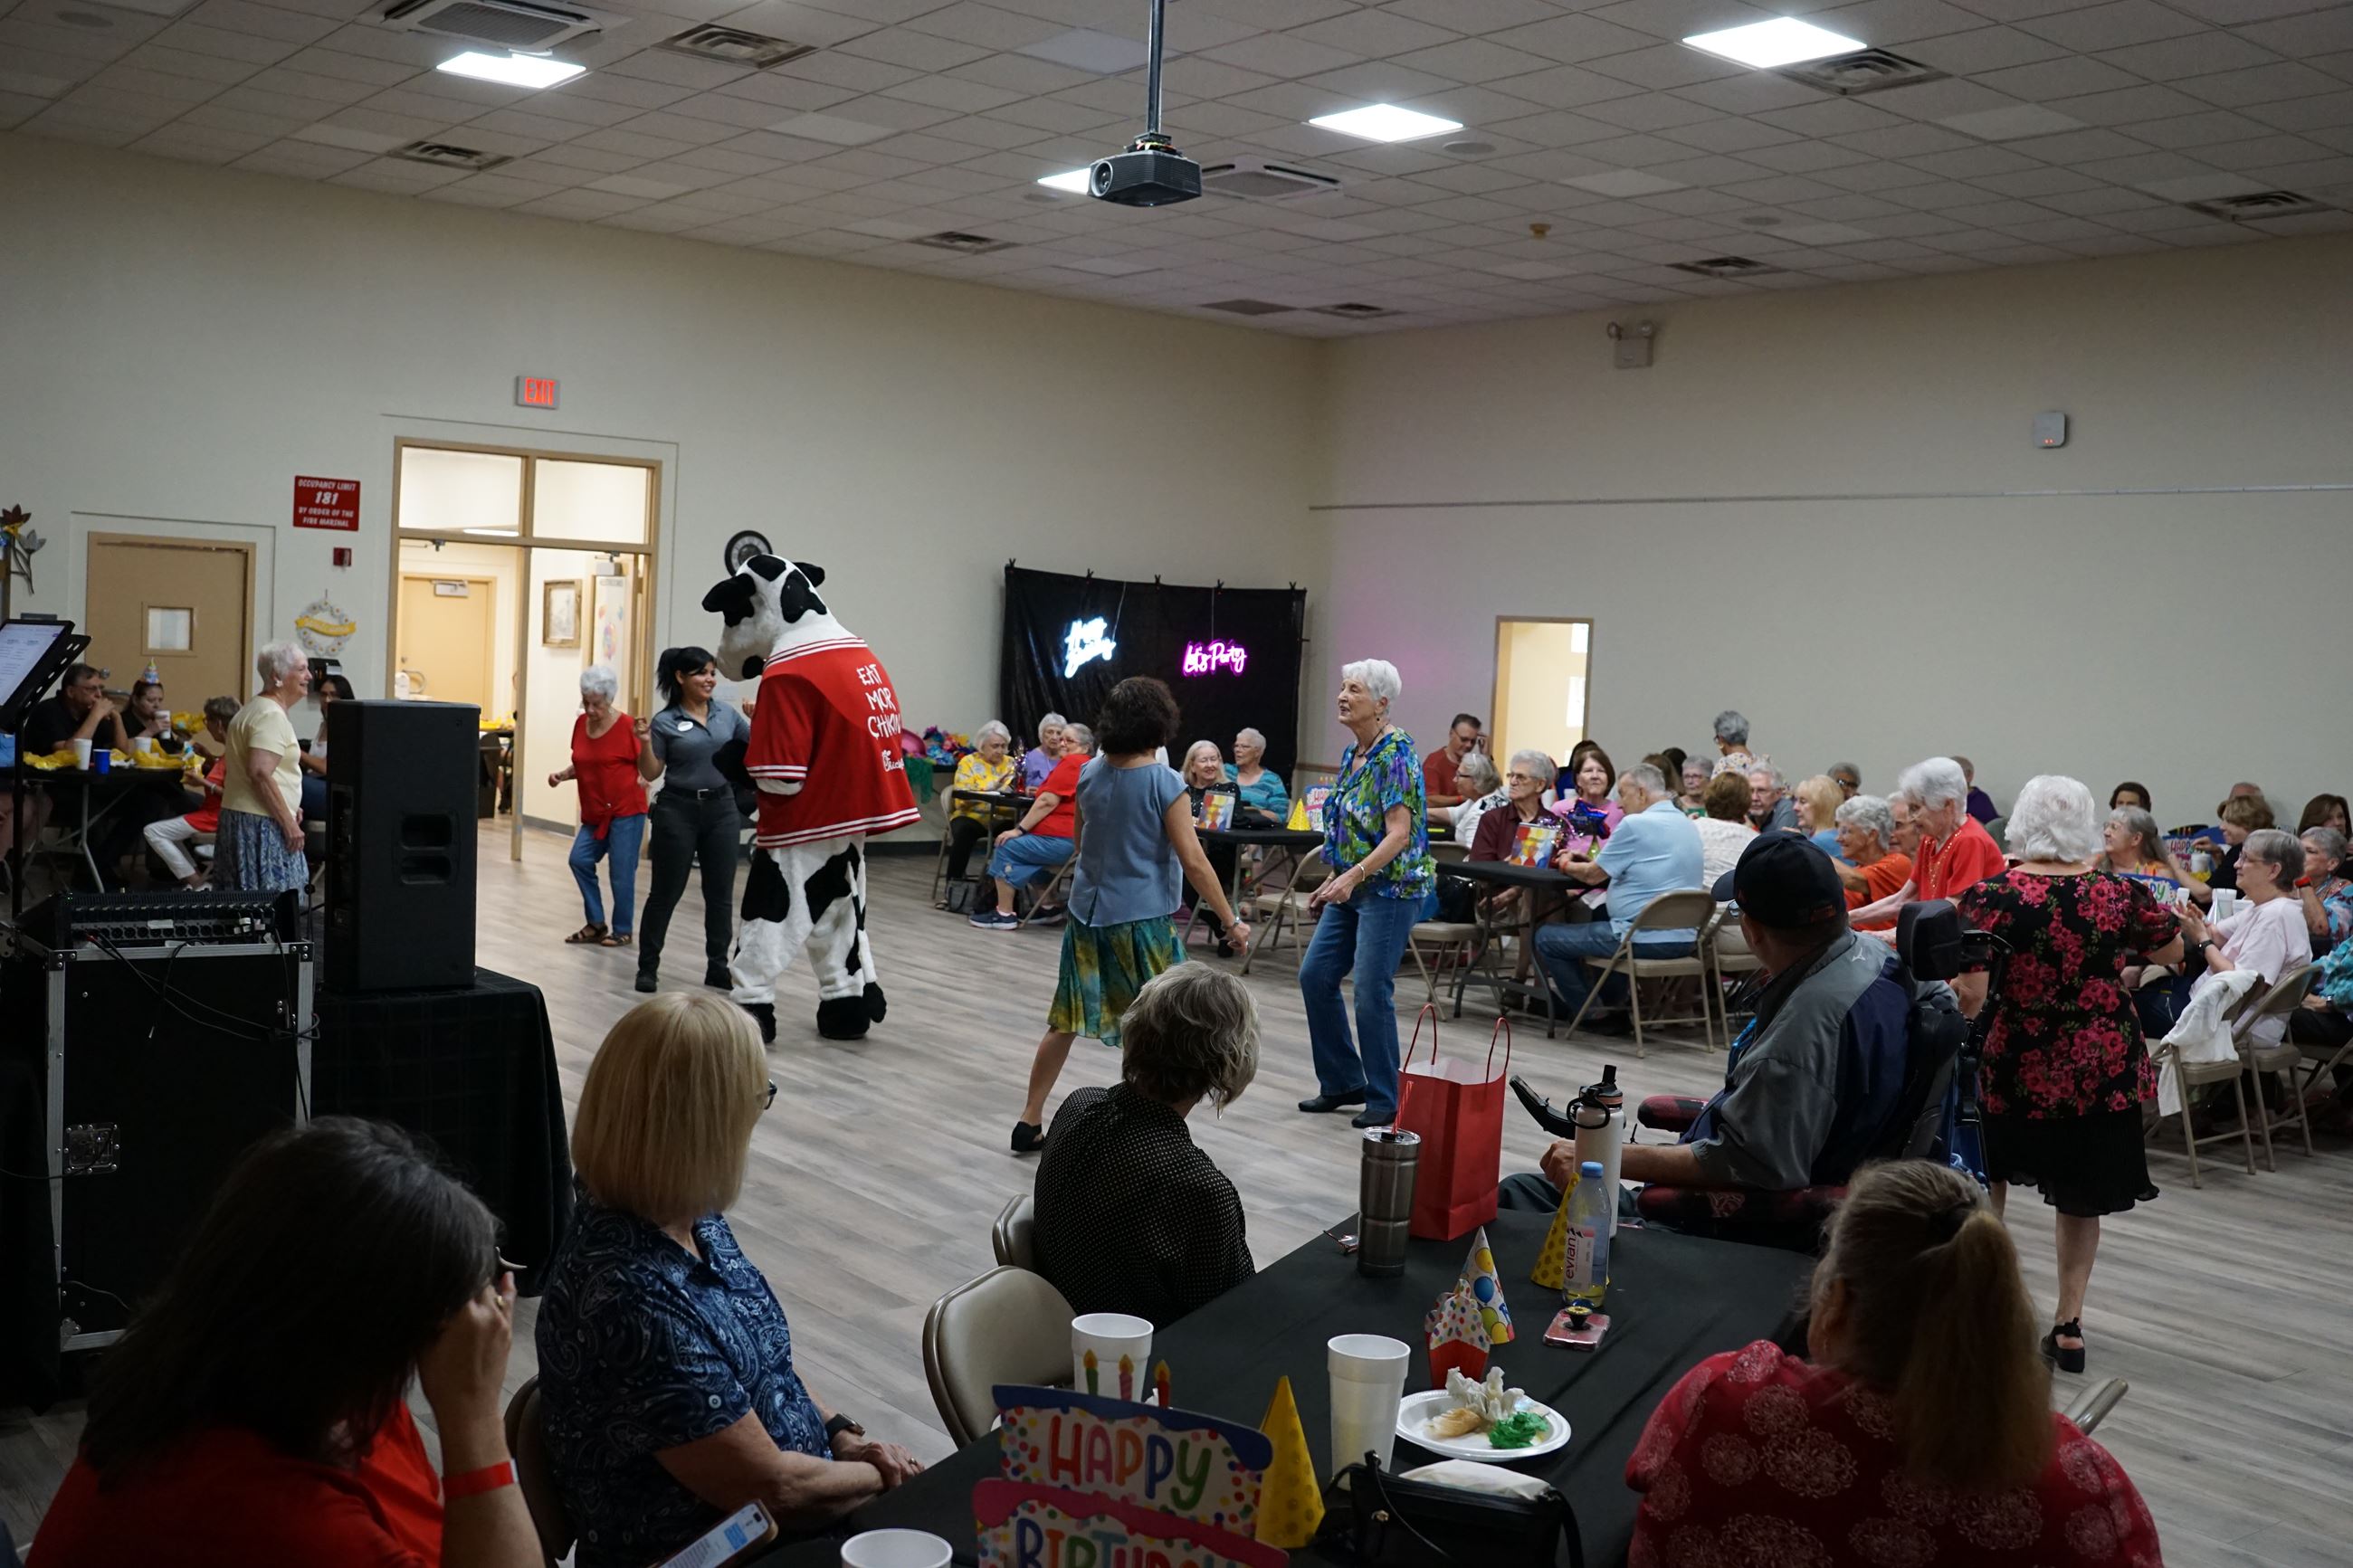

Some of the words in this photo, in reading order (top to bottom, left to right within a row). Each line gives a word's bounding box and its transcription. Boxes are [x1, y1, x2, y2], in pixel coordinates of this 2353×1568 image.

[524, 377, 557, 406] EXIT
[298, 479, 337, 489] OCCUPANCY
[337, 482, 356, 491] LIMIT
[315, 491, 338, 506] 181
[308, 508, 330, 516] ORDER
[331, 508, 340, 517] OF
[341, 509, 354, 518] THE
[319, 518, 348, 527] MARSHAL
[856, 663, 882, 686] EAT
[865, 687, 896, 714] MOR
[2169, 839, 2191, 853] HAPP
[1048, 1414, 1213, 1512] HAPPY
